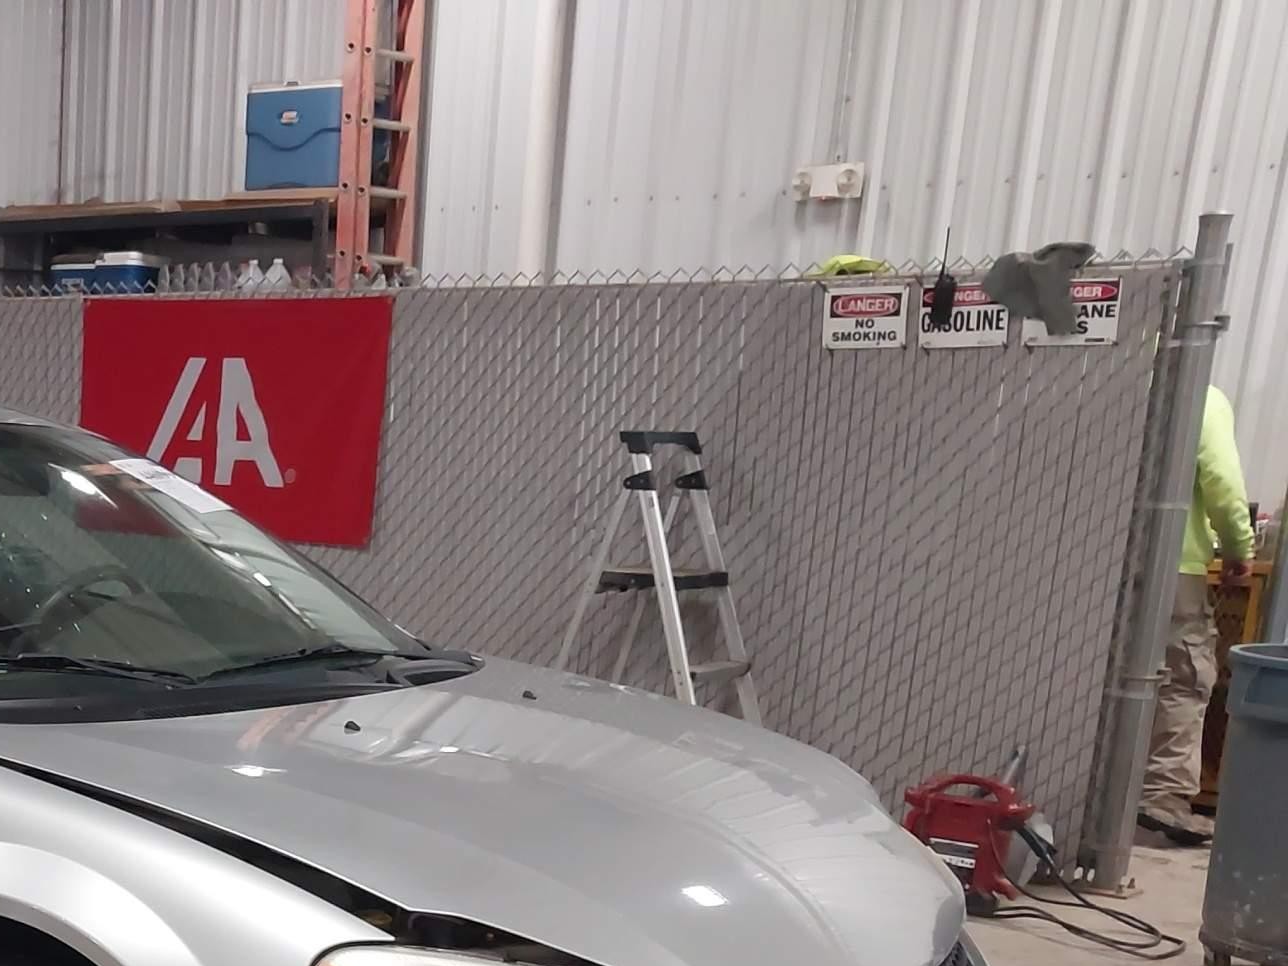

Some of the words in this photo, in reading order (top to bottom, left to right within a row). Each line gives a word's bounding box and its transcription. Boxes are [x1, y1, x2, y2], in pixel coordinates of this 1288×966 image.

[1073, 286, 1102, 298] GER
[854, 318, 875, 329] NO
[831, 330, 898, 342] SMOKING
